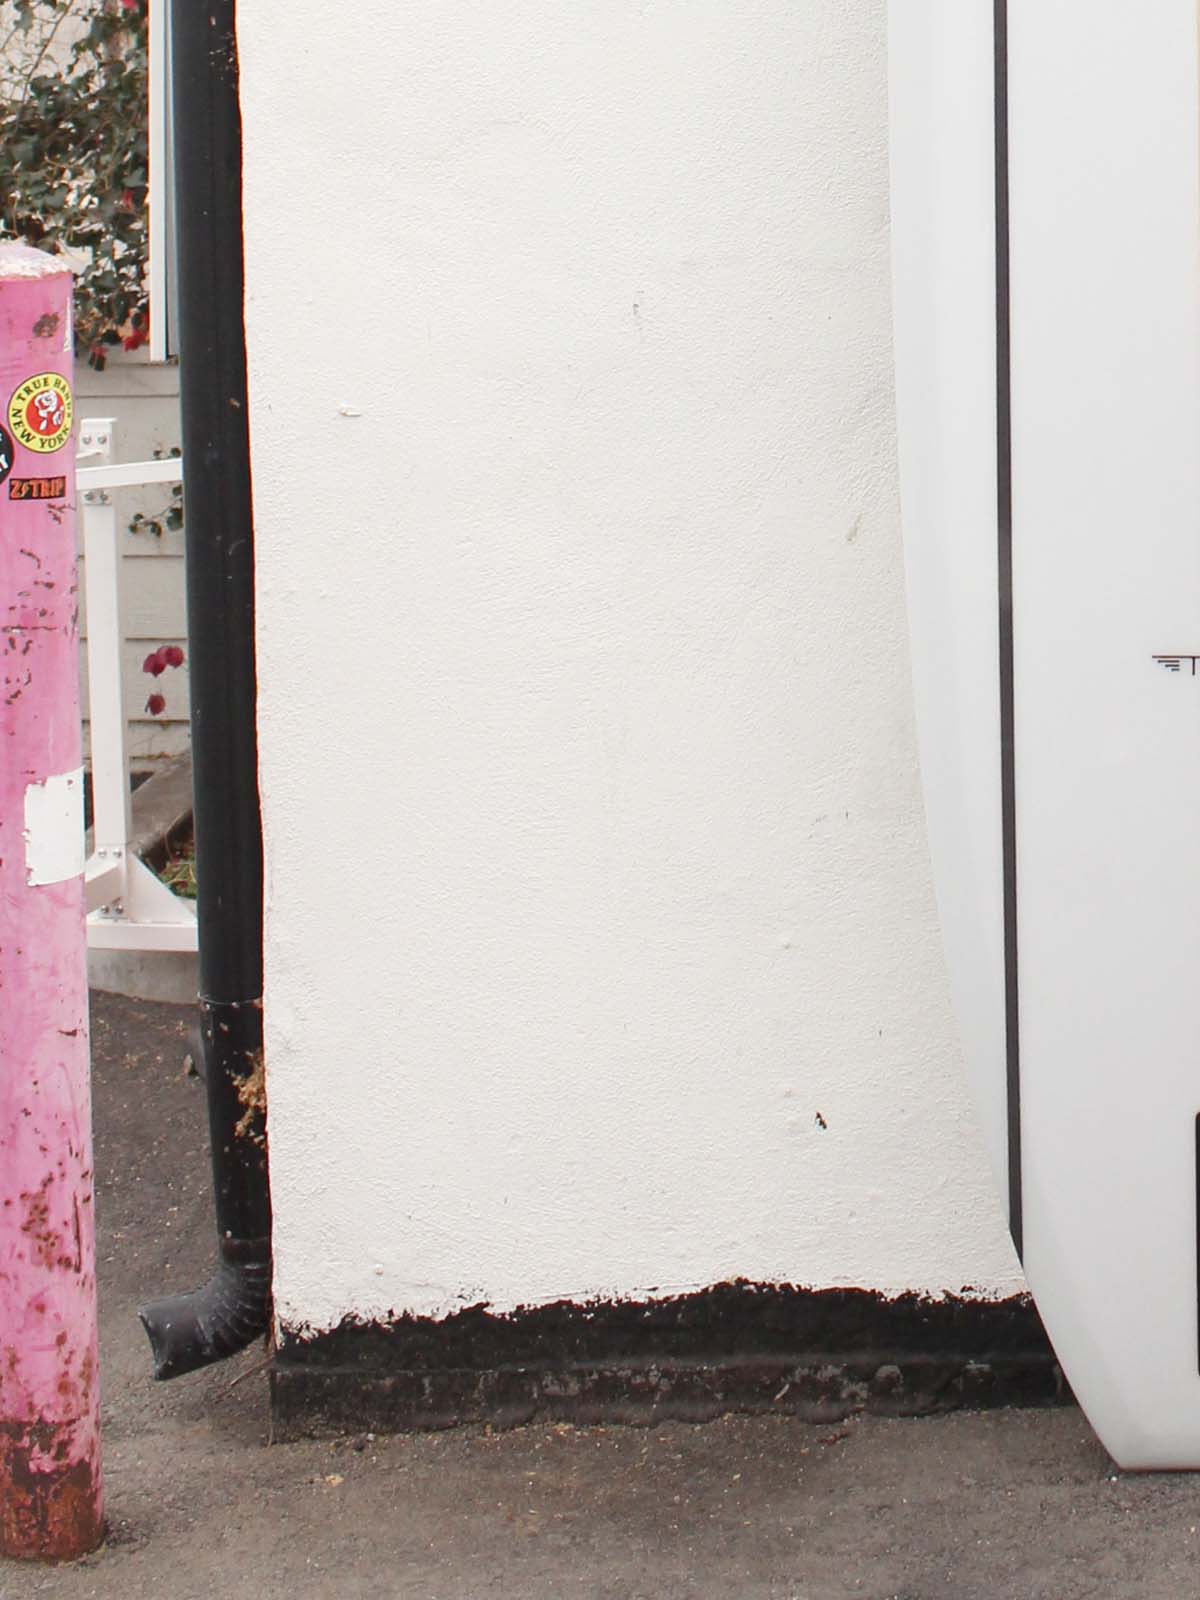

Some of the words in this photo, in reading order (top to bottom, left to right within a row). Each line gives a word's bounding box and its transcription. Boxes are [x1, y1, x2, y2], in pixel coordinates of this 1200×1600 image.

[15, 377, 50, 402] TRUE
[11, 408, 36, 444] NEW
[39, 427, 70, 449] YORK
